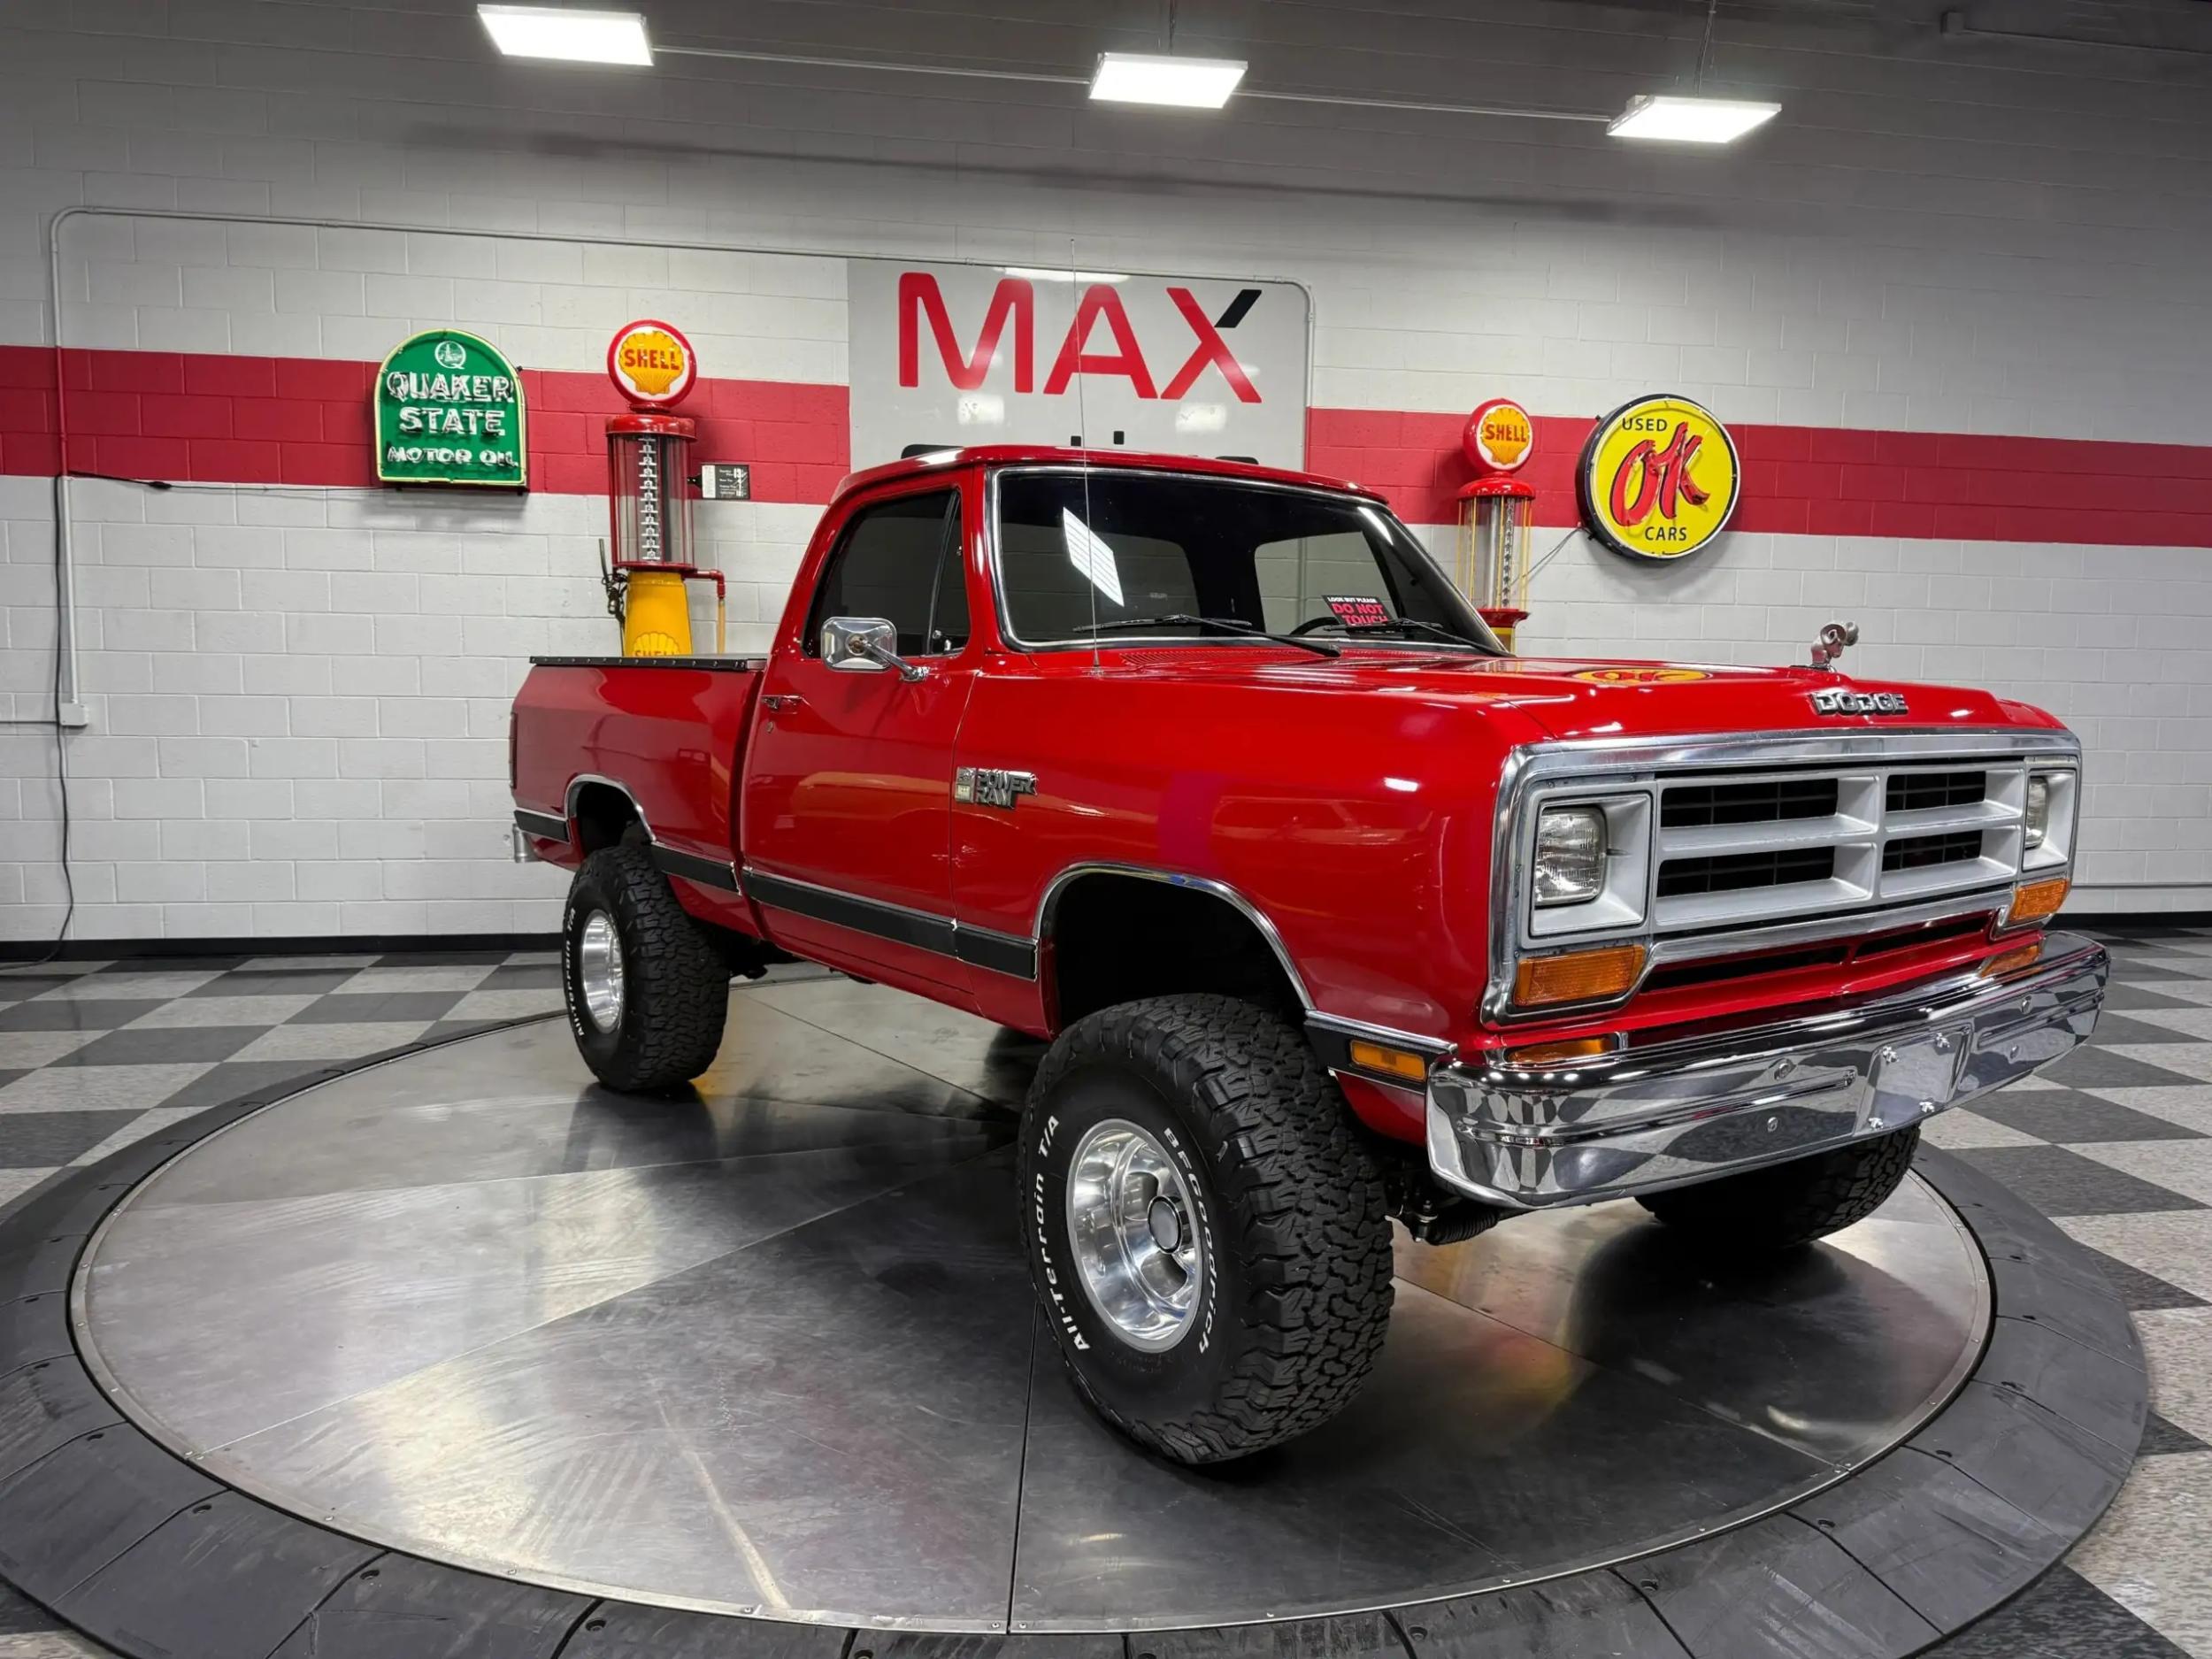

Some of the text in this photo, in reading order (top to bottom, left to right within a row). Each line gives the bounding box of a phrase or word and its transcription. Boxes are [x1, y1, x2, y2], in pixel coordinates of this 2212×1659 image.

[899, 273, 1263, 403] MAX
[624, 349, 680, 371] SHELL
[387, 371, 515, 403] QUAKER
[399, 406, 506, 436] STATE
[1484, 423, 1527, 443] SHELL
[1621, 418, 1668, 432] USED
[387, 445, 518, 468] MOTOR OIL
[1609, 421, 1710, 526] OK
[1644, 526, 1687, 541] CARS
[1332, 603, 1384, 615] DO NOT
[1809, 692, 1909, 715] DODGE
[975, 767, 1038, 796] POWER
[1033, 1115, 1091, 1352] All-Terrain T/A
[1163, 1126, 1218, 1355] BFGoodrich
